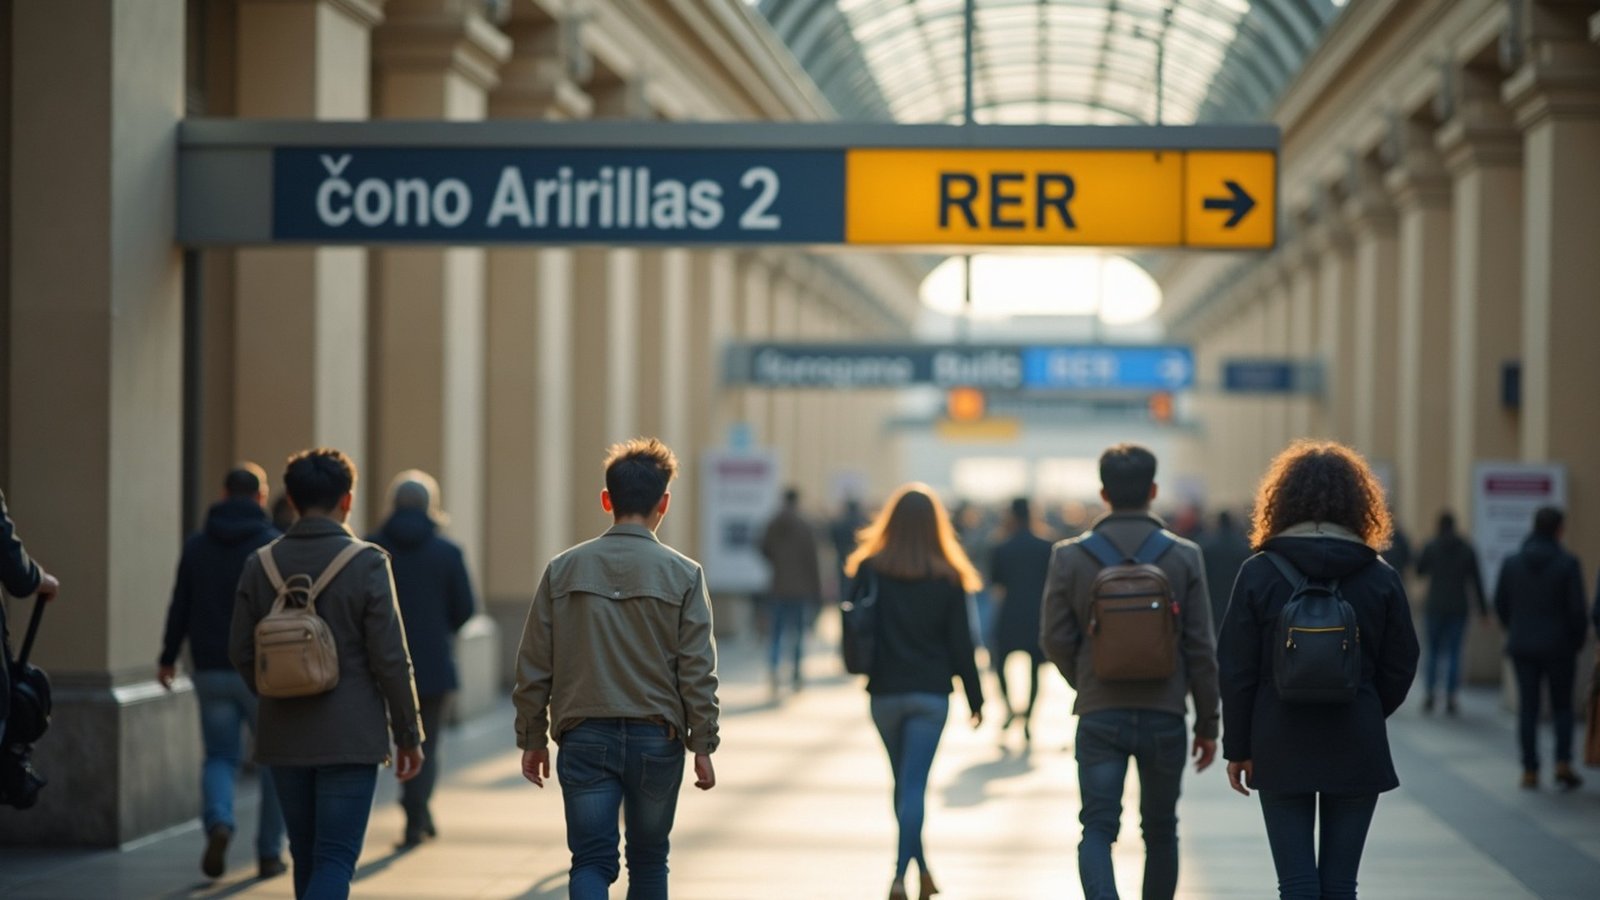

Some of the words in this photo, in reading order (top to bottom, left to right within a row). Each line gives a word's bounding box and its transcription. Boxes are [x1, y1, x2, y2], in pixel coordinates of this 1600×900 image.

[487, 166, 725, 229] Aririllas
[738, 167, 782, 231] 2
[938, 171, 1077, 231] RER
